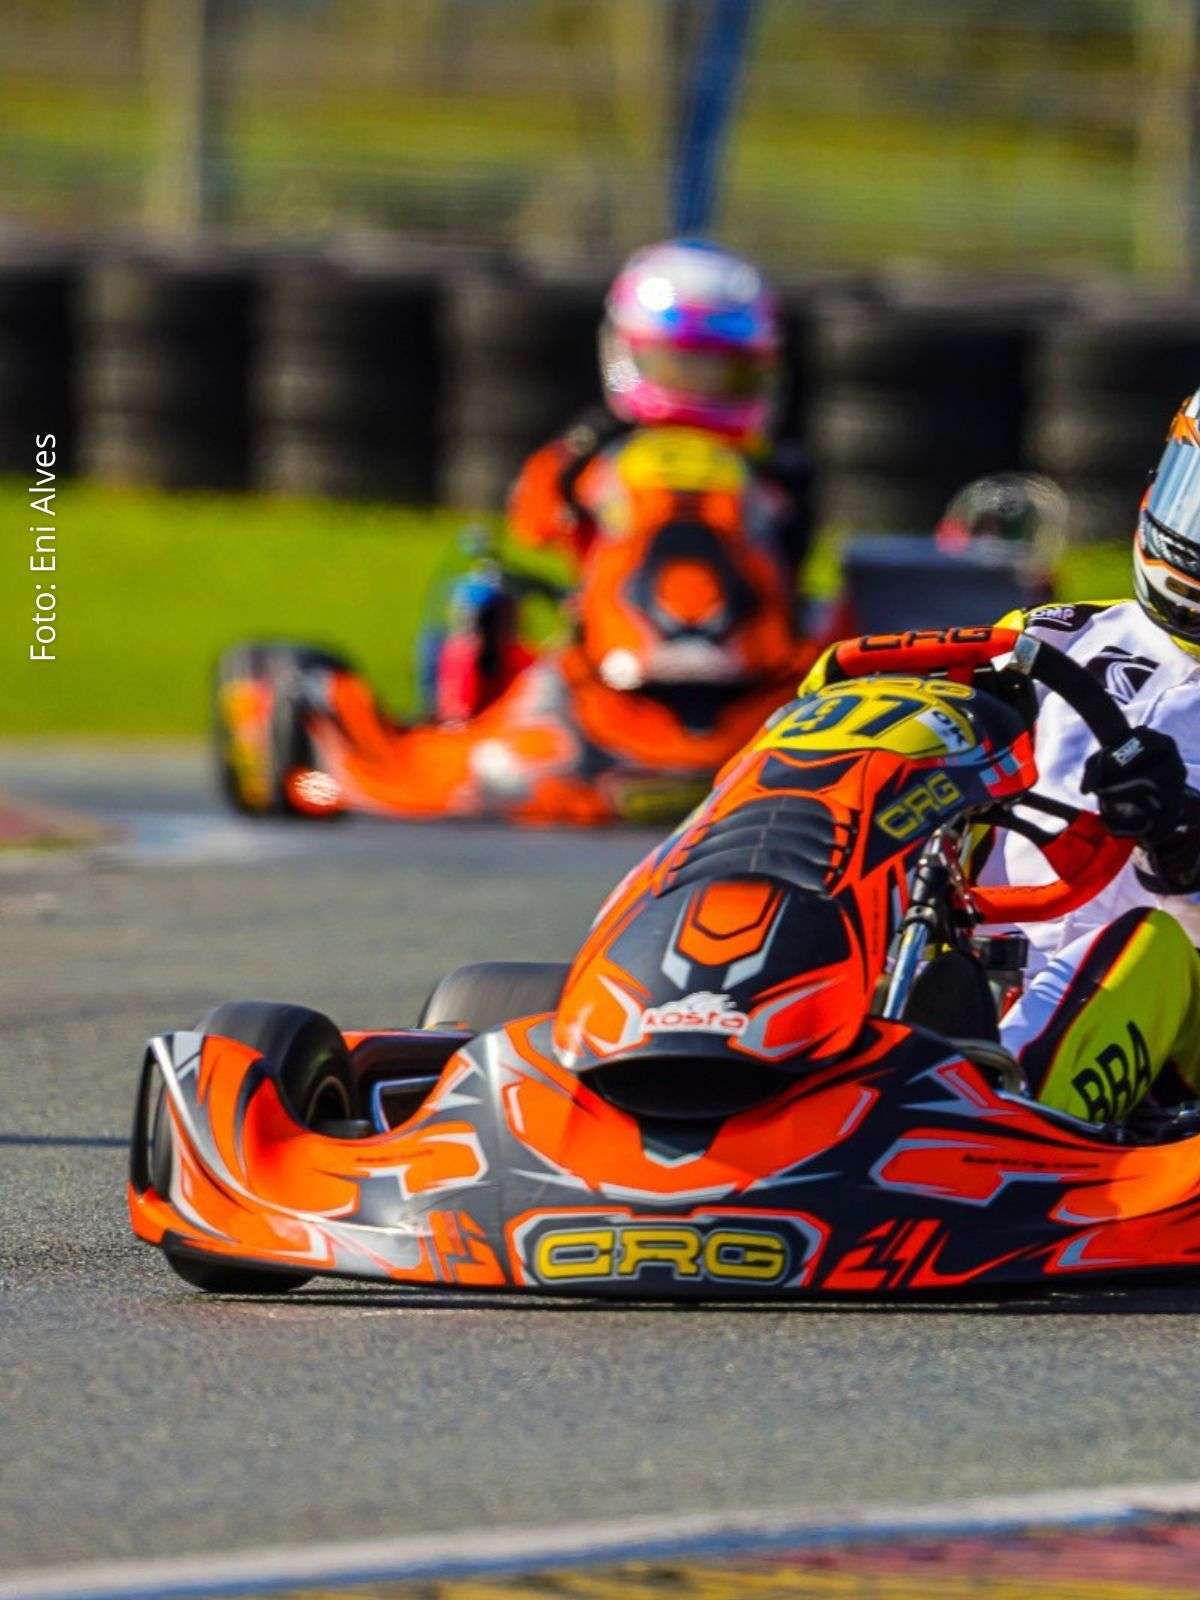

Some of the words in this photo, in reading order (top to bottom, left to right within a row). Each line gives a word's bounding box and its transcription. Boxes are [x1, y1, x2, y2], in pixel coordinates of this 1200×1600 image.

[780, 693, 927, 739] 97
[876, 768, 961, 838] CRG
[1072, 1019, 1152, 1122] BRA
[536, 1226, 787, 1282] CRG
